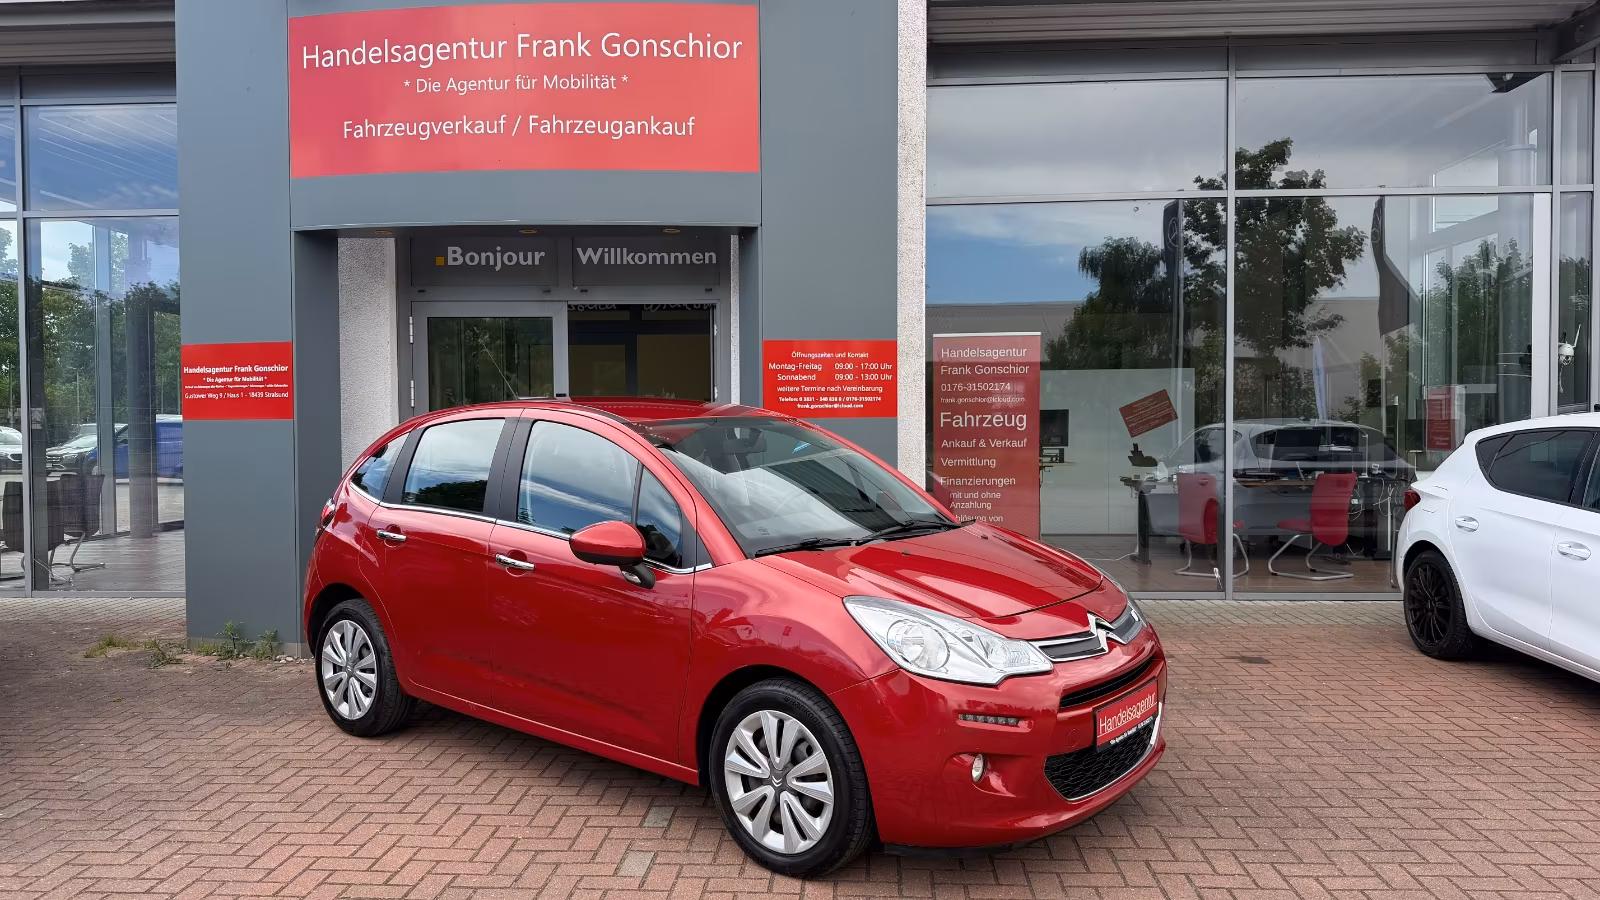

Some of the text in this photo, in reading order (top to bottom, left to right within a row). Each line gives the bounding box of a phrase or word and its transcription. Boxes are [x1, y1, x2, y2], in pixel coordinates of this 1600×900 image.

[302, 32, 743, 71] Handelsagentur Frank Gonschior
[416, 73, 617, 96] Die Agentur für Mobilität
[343, 114, 695, 140] Fahrzeugverkauf / Fahrzeugankauf
[447, 246, 546, 271] Bonjour
[576, 247, 717, 265] Willkommen
[791, 351, 834, 359] Öffnungszeiten
[941, 347, 1027, 359] Handelsagentur
[183, 363, 289, 374] Handelsagentur Frank Gonschior
[768, 363, 823, 371] Montag-Freitag
[940, 364, 1029, 375] Frank Gonschior
[842, 385, 883, 393] Vereinbarung
[940, 382, 1011, 392] 0176-31502174
[940, 411, 1027, 431] Fahrzeug
[941, 437, 1027, 448] Ankauf & Verkauf
[941, 457, 997, 469] Vermittlung
[940, 476, 1016, 488] Finanzierungen
[950, 491, 1001, 499] mit und ohne
[949, 501, 992, 510] Anzahlung
[1100, 692, 1156, 735] Handelsagentur
